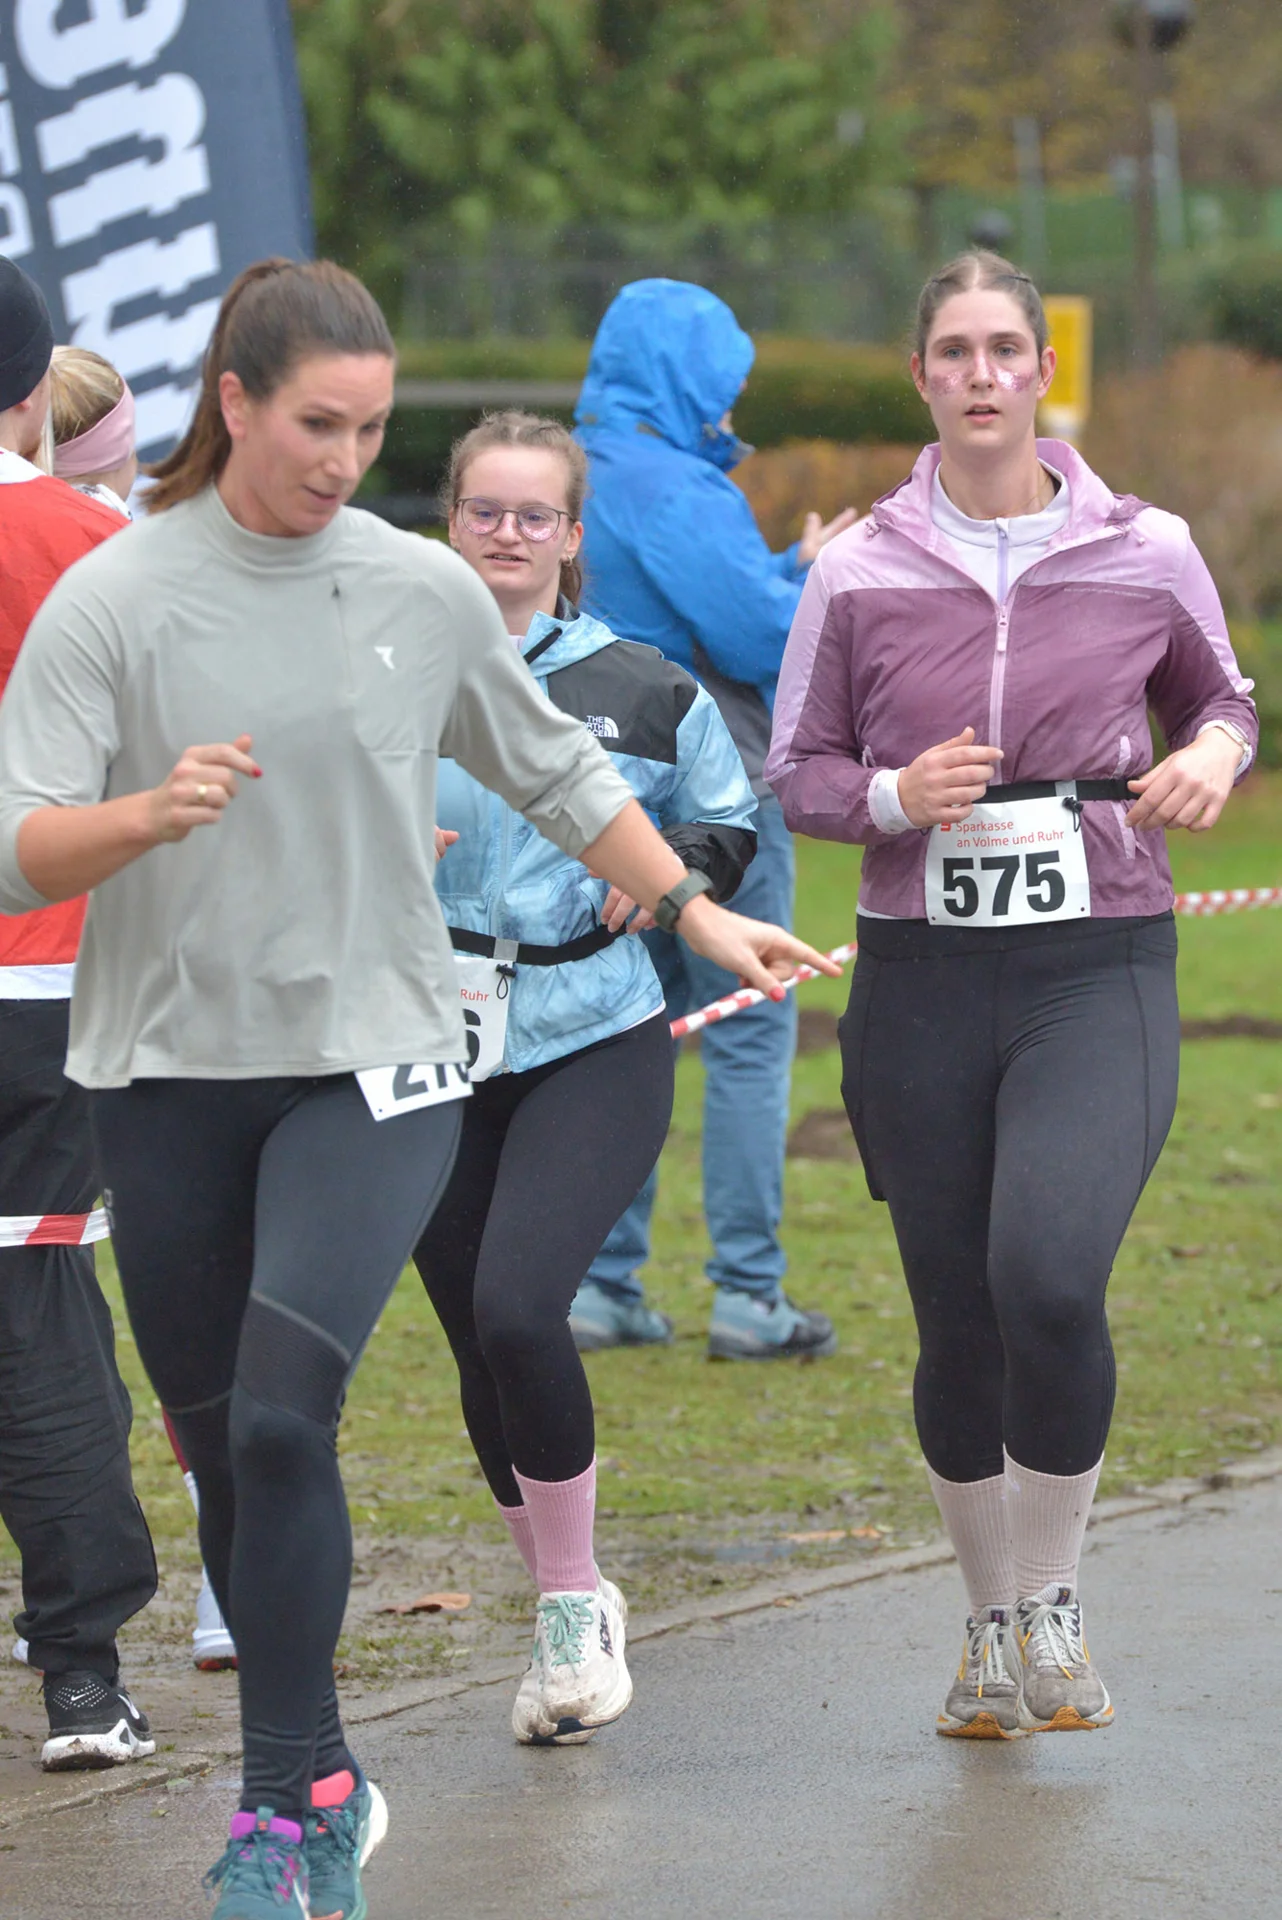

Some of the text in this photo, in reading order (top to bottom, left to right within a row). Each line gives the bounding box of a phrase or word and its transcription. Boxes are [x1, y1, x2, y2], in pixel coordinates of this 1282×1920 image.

[586, 715, 604, 723] THE
[580, 722, 604, 730] ORTH
[587, 729, 604, 737] ACE
[956, 820, 1014, 833] Sparkasse
[957, 830, 1064, 848] an Volme und Ruhr
[943, 850, 1066, 918] 575
[460, 988, 489, 1002] Ruhr
